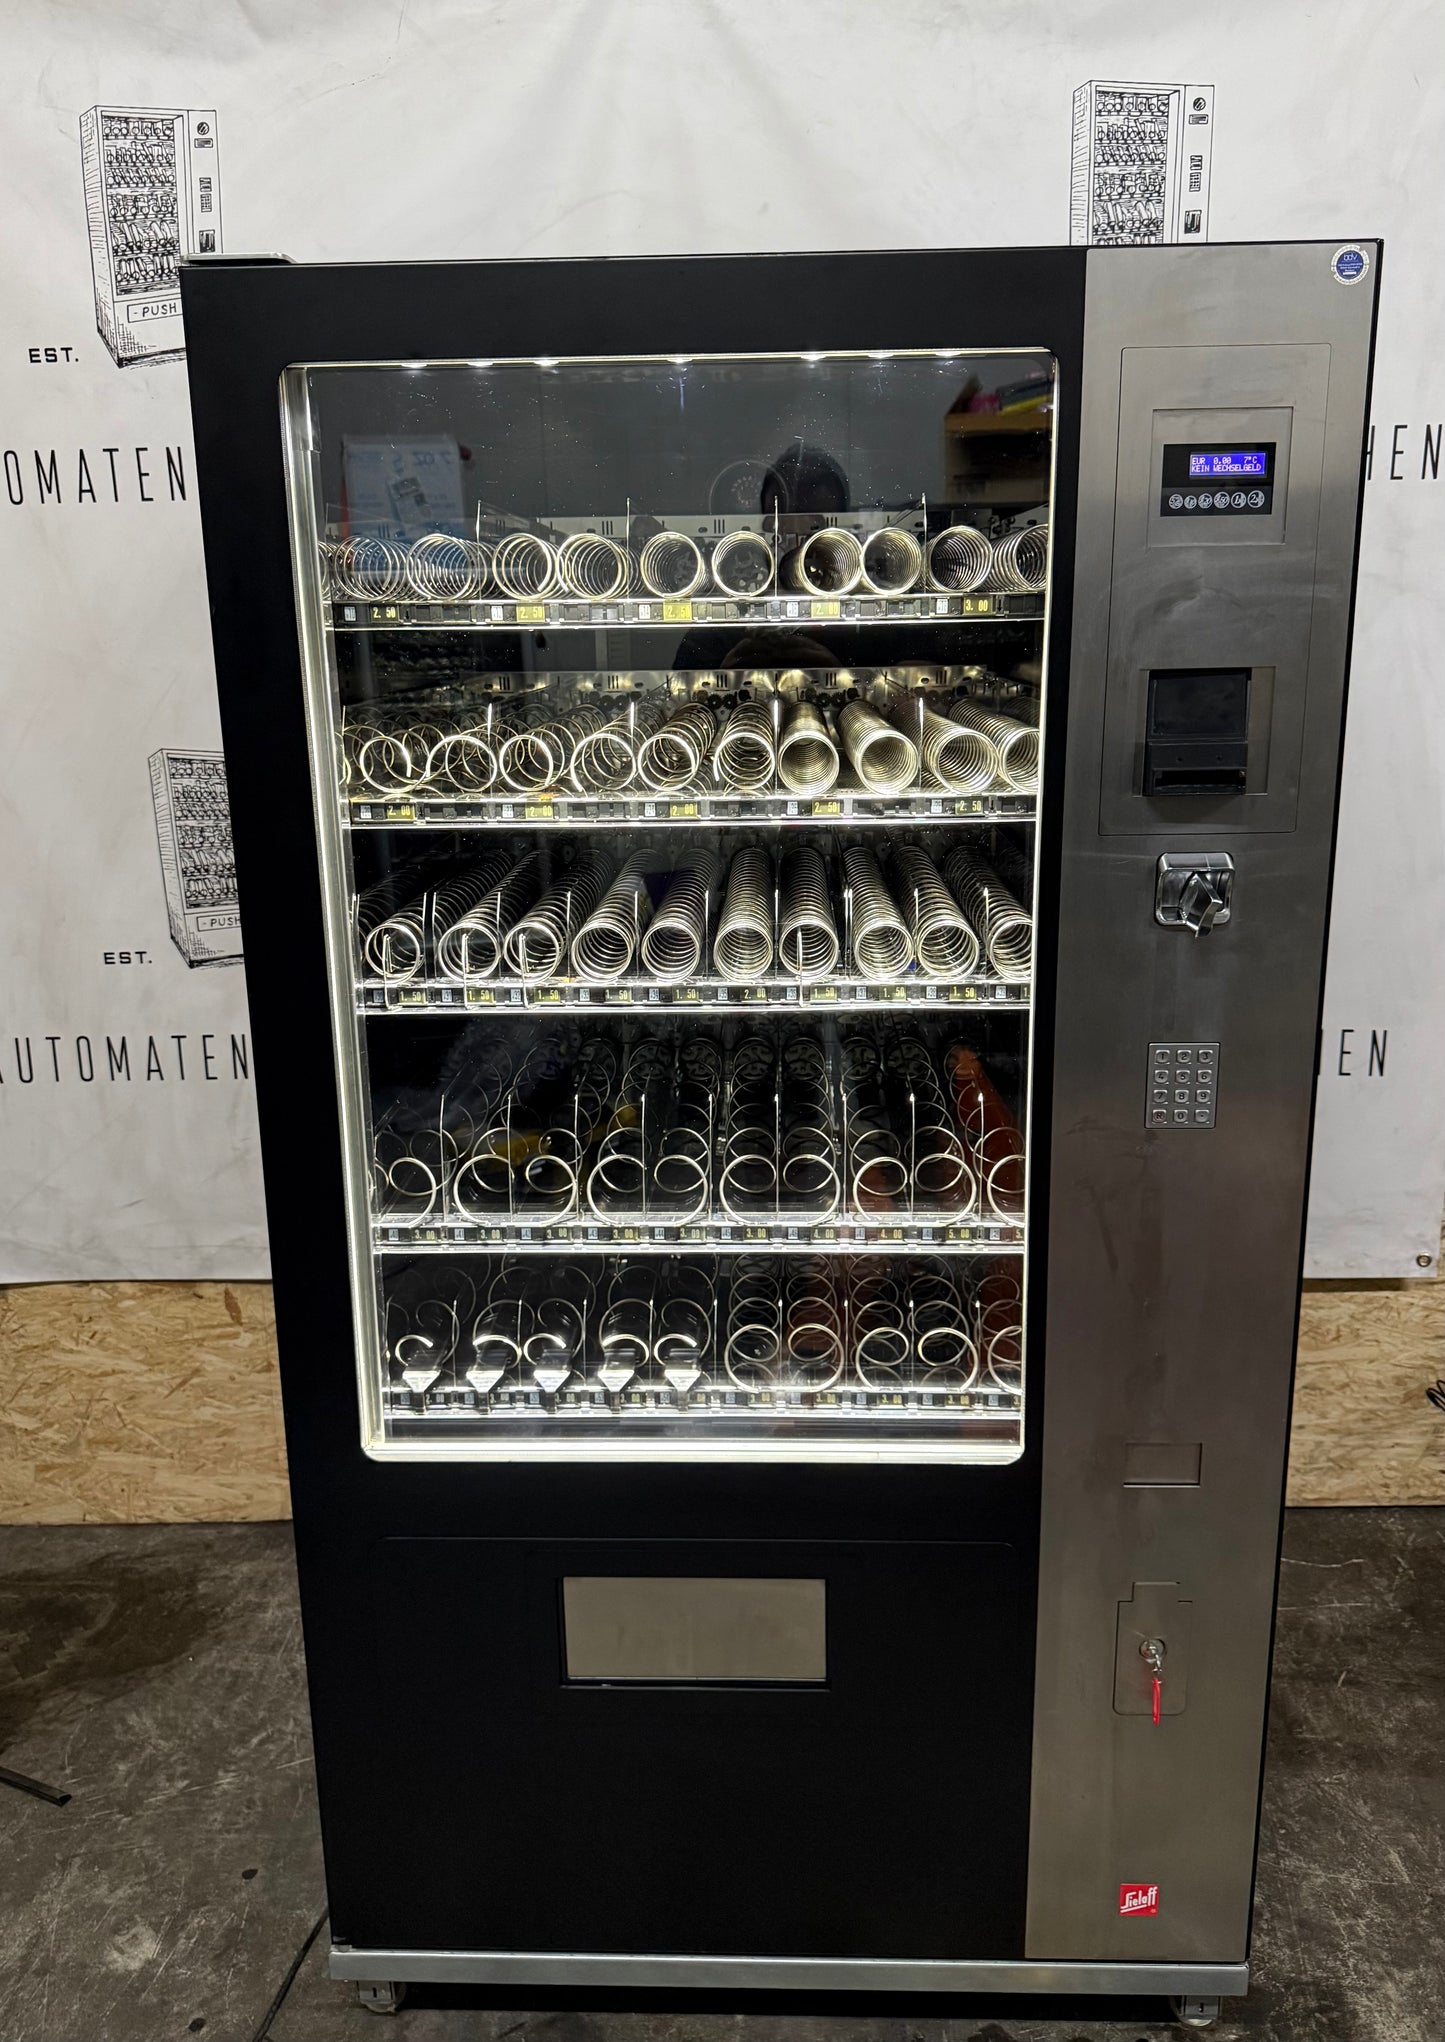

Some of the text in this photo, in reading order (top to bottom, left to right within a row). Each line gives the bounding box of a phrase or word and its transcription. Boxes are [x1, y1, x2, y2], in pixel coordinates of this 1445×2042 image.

[142, 303, 177, 317] PUSH
[28, 347, 79, 363] EST.
[1213, 456, 1232, 464] 0.00
[4, 446, 187, 505] OMATEN
[1191, 464, 1262, 473] KEIN WECHSELGELD
[210, 916, 241, 928] PUSH
[104, 951, 153, 965] EST.
[0, 1034, 249, 1084] UTOMATEN
[1318, 1029, 1387, 1077] EN
